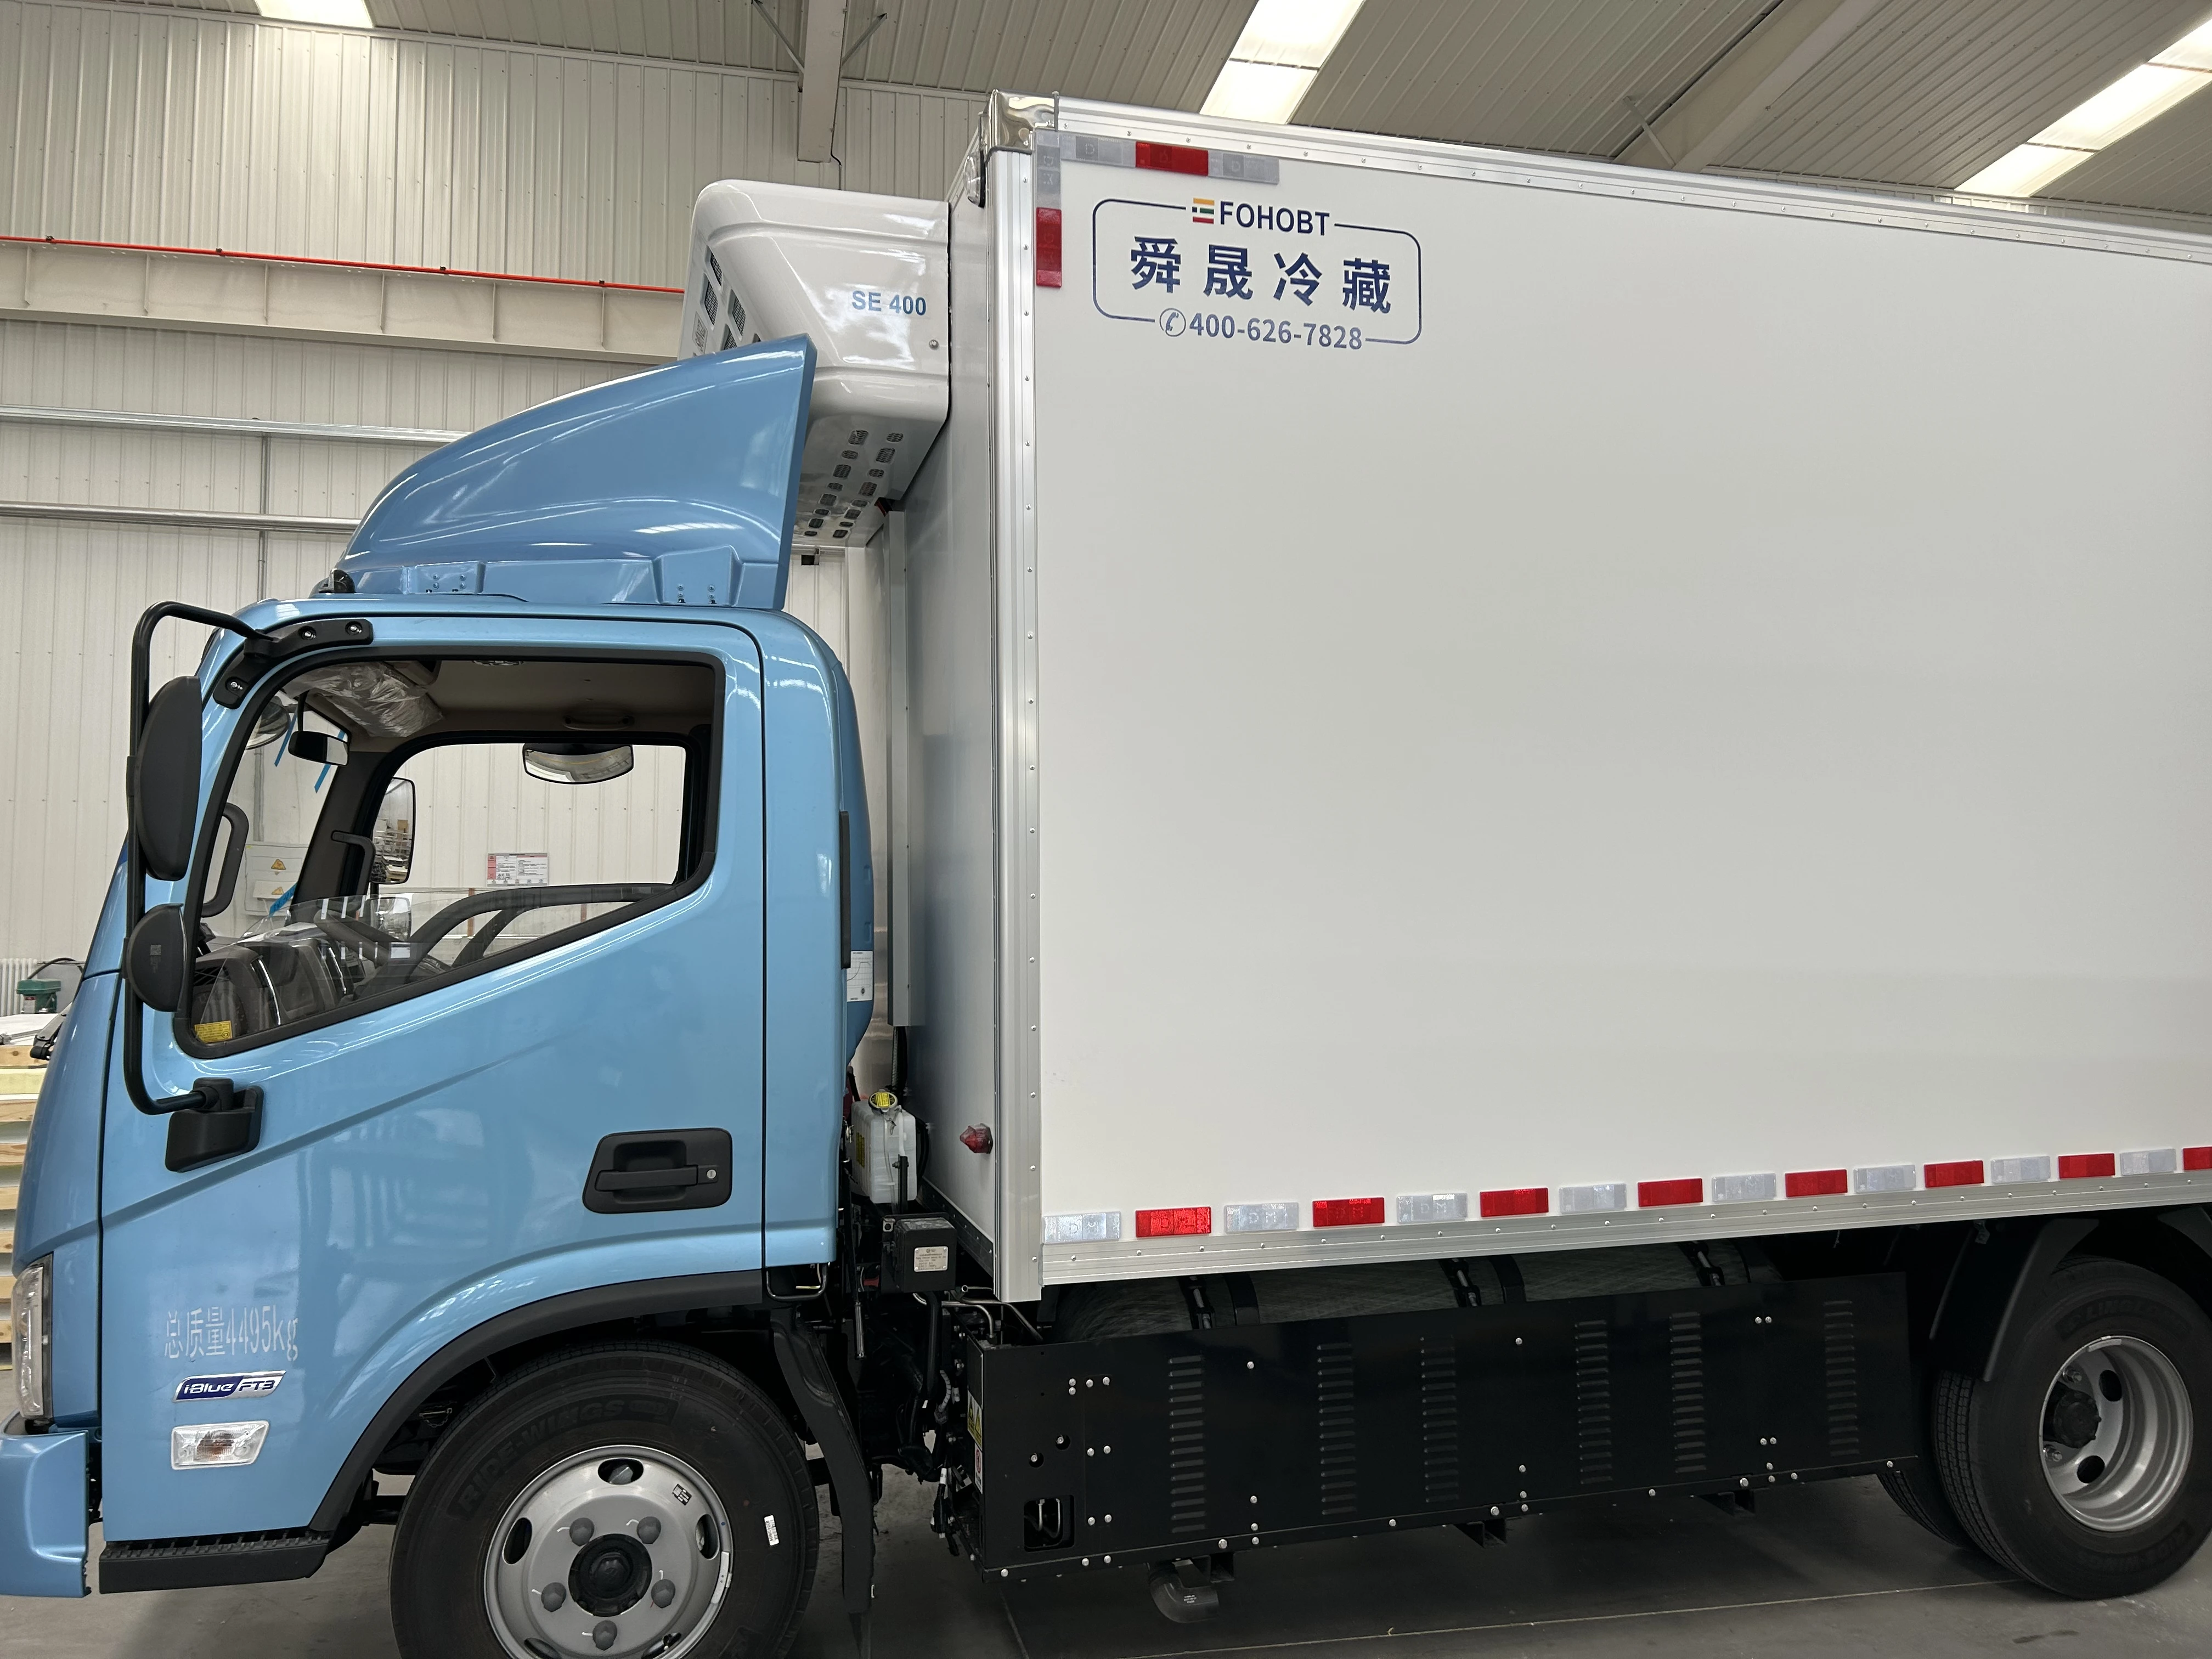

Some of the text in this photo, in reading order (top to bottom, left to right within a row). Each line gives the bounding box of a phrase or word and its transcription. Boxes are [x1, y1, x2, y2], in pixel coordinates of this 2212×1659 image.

[1220, 200, 1330, 236] FOHOBT
[1130, 236, 1391, 314] 舜晟冷藏
[851, 290, 927, 316] SE 400
[1188, 312, 1363, 350] 400-626-7828
